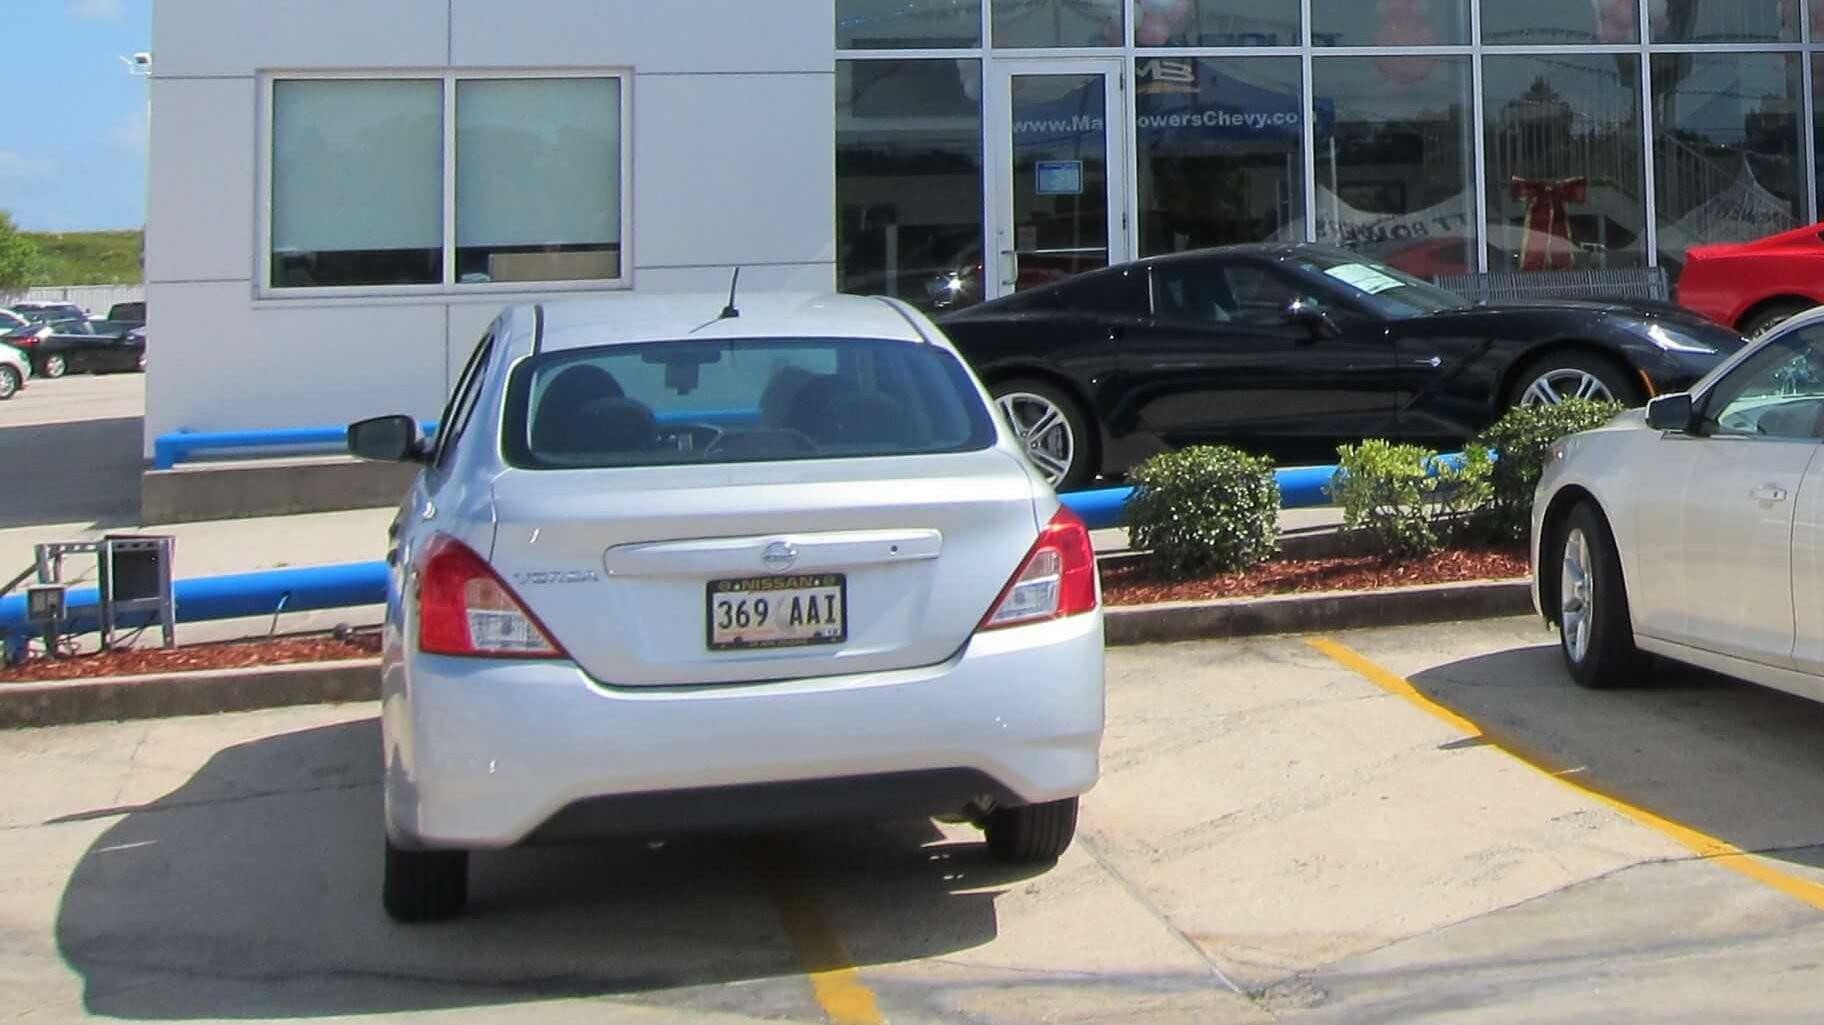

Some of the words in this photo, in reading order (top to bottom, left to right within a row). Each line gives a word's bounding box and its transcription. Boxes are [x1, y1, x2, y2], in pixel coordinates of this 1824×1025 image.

[1012, 110, 1317, 134] www.MaowersChevy.co
[741, 577, 813, 591] NISSAN
[718, 598, 768, 629] 369
[789, 594, 836, 626] AAI
